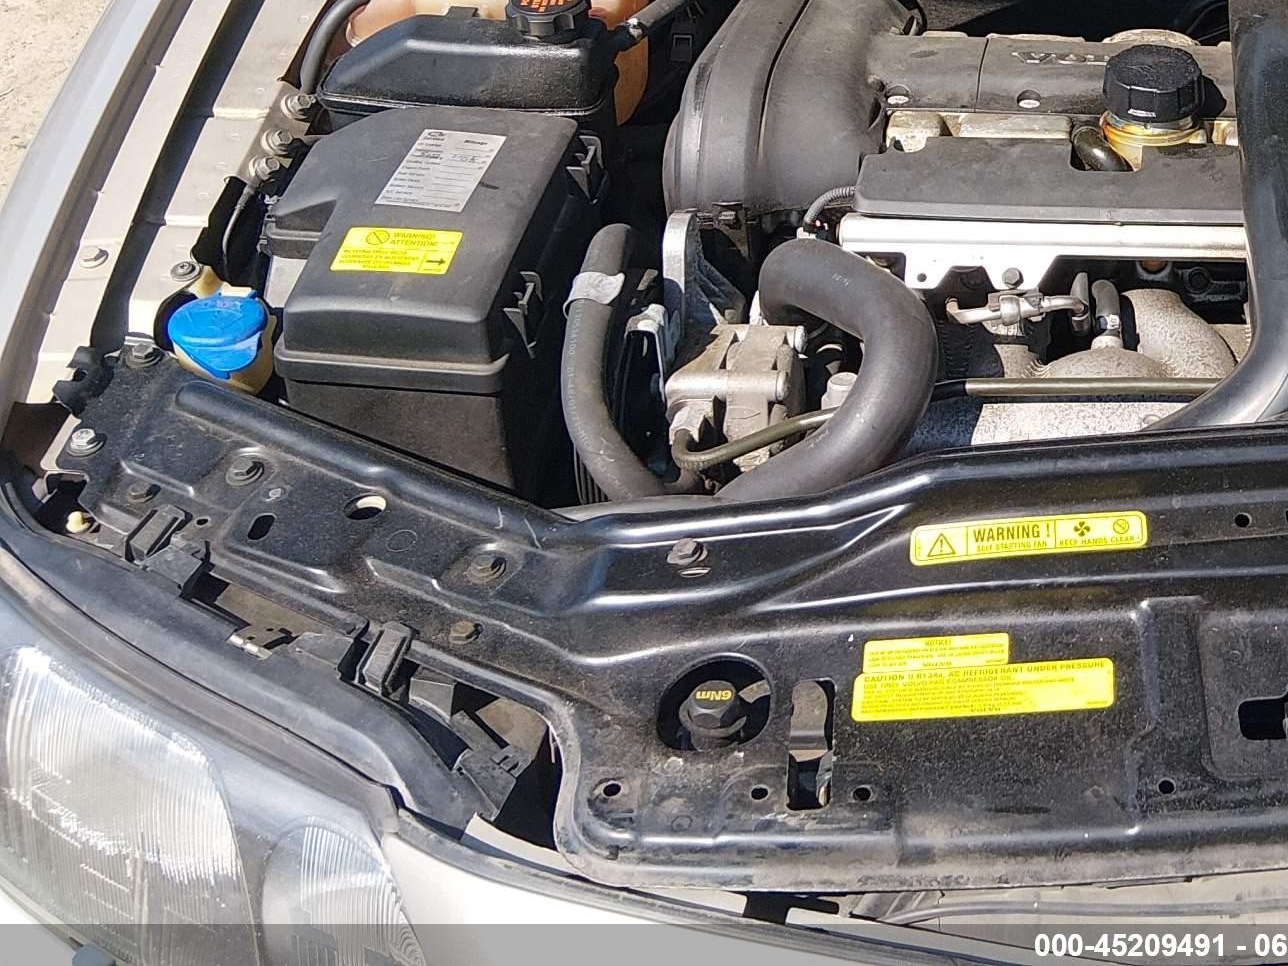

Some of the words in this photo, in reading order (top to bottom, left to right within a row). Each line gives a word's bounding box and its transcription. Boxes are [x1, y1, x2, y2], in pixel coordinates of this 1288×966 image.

[1011, 51, 1109, 66] VOL
[973, 523, 1041, 544] WARNING
[1046, 521, 1051, 538] !
[976, 542, 994, 553] SELF
[996, 540, 1032, 552] STARTING
[1033, 539, 1048, 548] FAN
[1059, 537, 1080, 548] KEEP
[1081, 536, 1109, 546] HANDS
[1110, 534, 1136, 544] CLEAR
[864, 674, 905, 683] CAUTION
[948, 670, 961, 678] AC
[963, 665, 1023, 677] REFRIGERANT
[1026, 664, 1057, 673] UNDER
[1059, 660, 1105, 671] PRESSURE
[946, 675, 998, 685] COMPRESSOR
[695, 690, 732, 701] 6Nm
